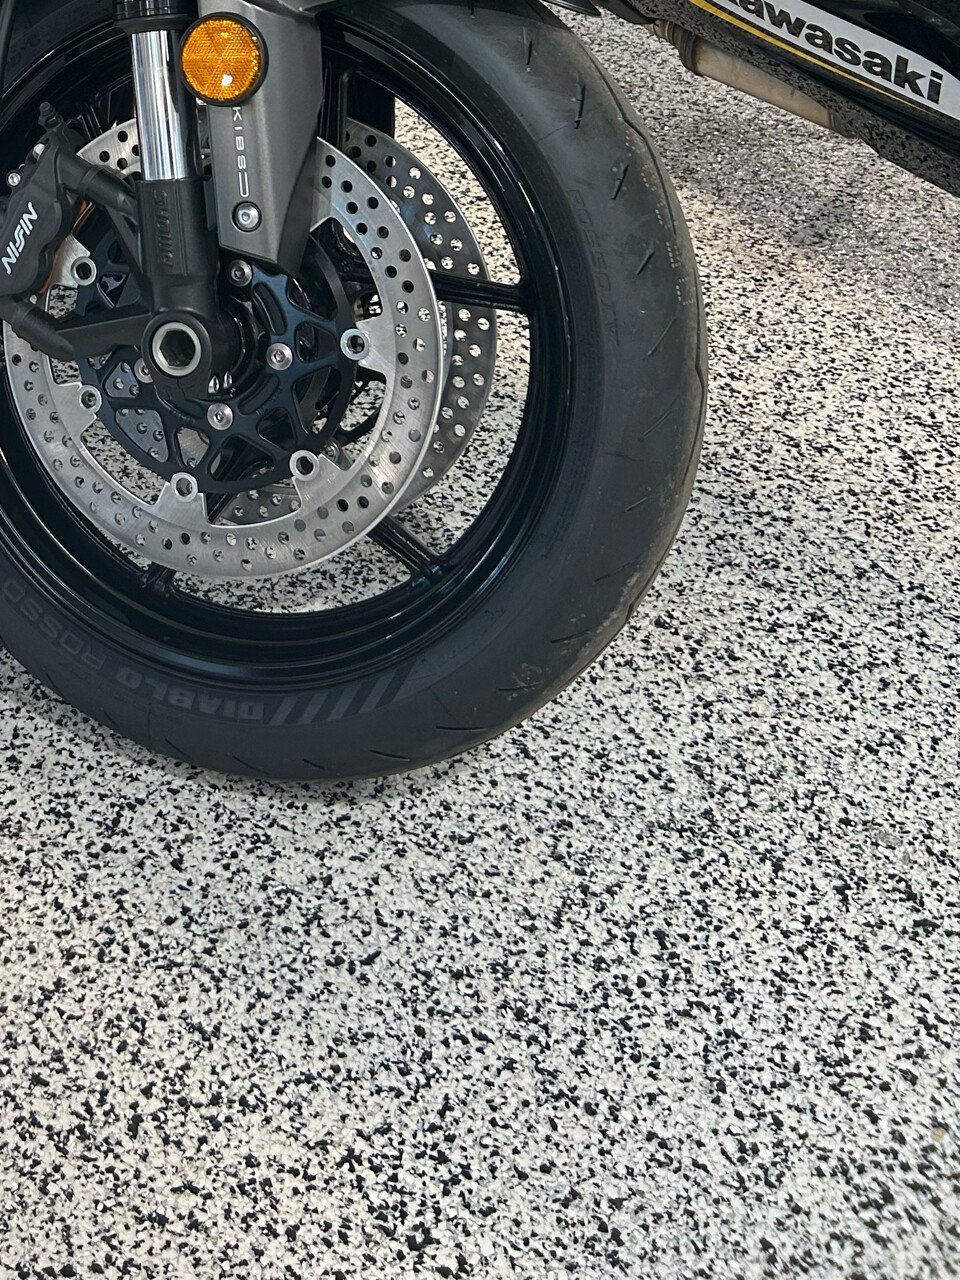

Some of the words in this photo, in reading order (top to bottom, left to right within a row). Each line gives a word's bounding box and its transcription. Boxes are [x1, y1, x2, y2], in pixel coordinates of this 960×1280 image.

[232, 106, 247, 170] KIBS
[1, 578, 107, 670] ROSSO
[116, 668, 265, 720] DIABLO
